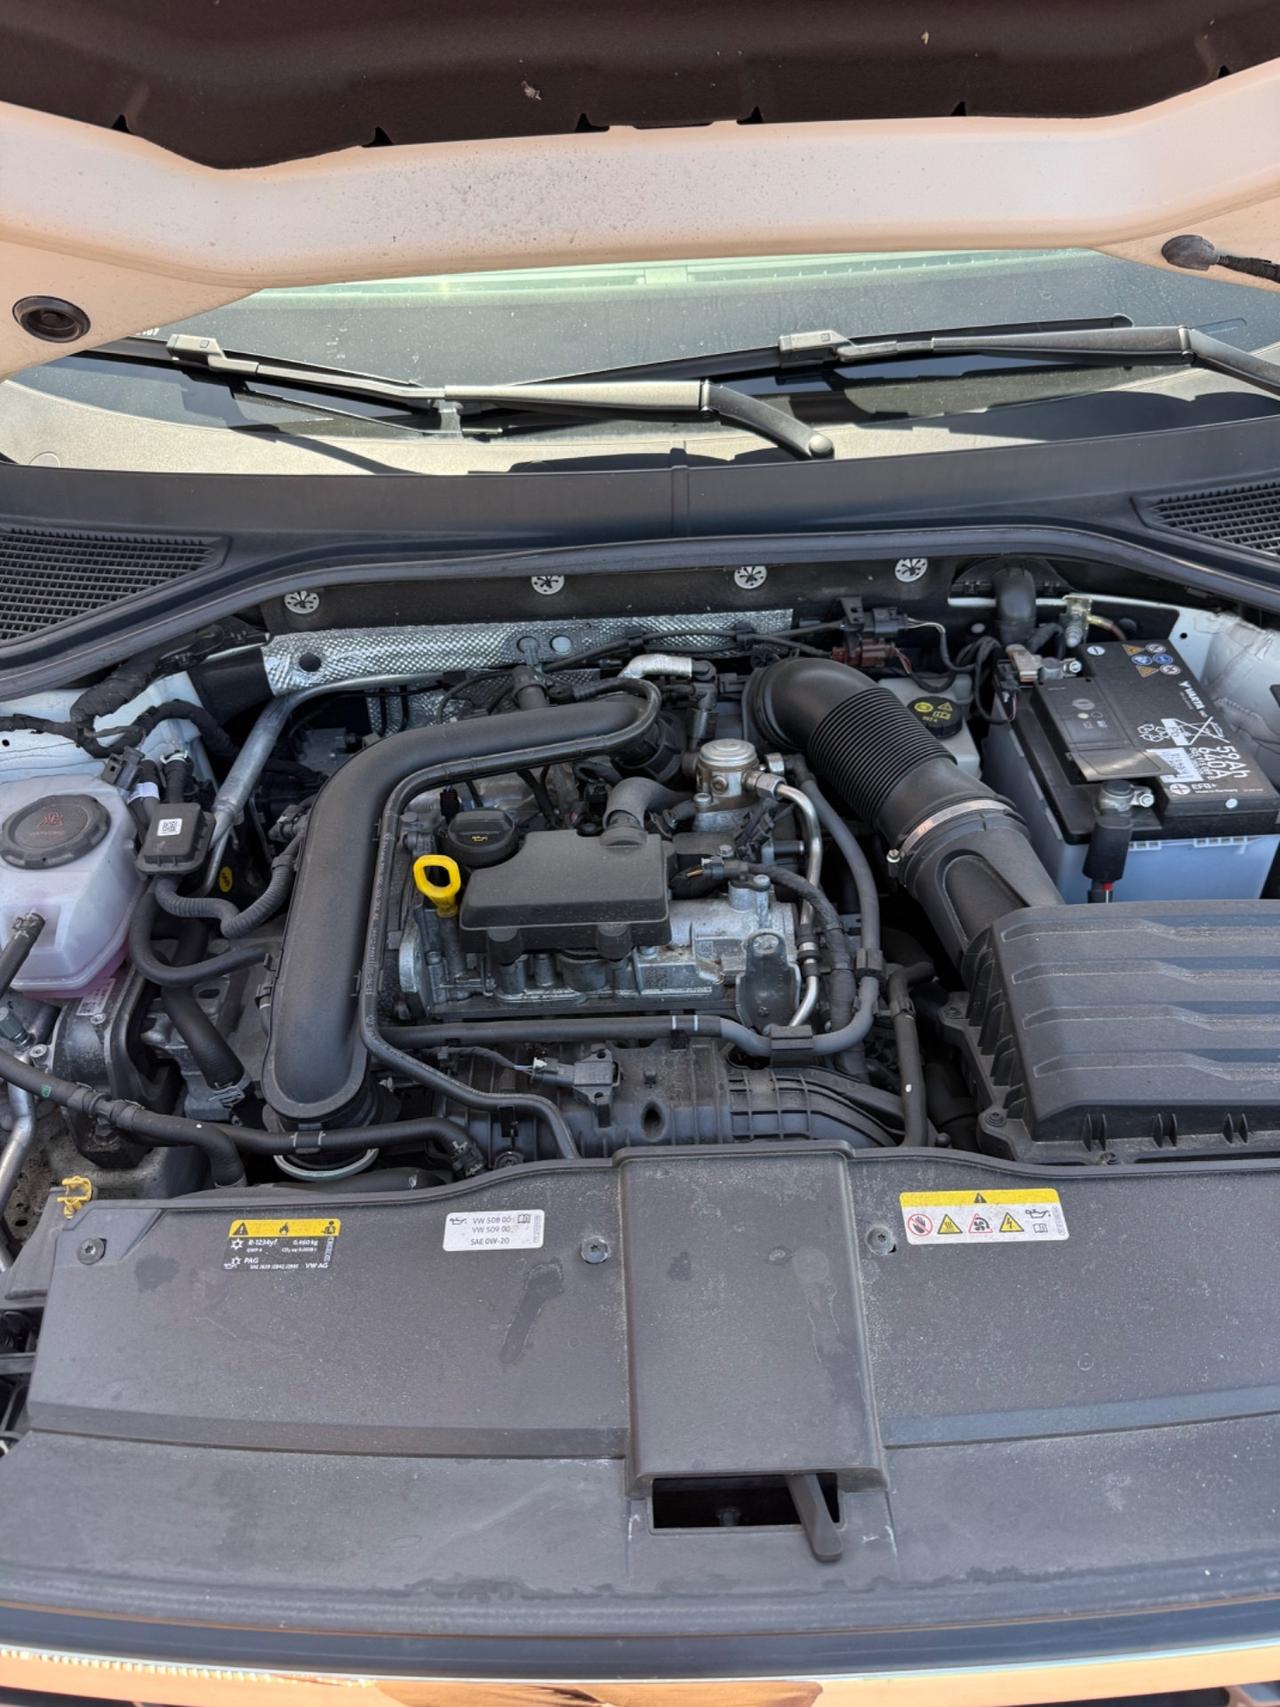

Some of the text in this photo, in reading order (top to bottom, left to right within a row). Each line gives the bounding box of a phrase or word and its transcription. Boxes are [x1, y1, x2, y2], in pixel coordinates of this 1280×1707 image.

[1198, 746, 1232, 779] 640A
[1216, 745, 1251, 778] 59Ah
[487, 1216, 501, 1224] 508
[248, 1238, 279, 1247] R-1234yf
[310, 1239, 319, 1247] kg
[470, 1237, 510, 1246] SAE 0W-20
